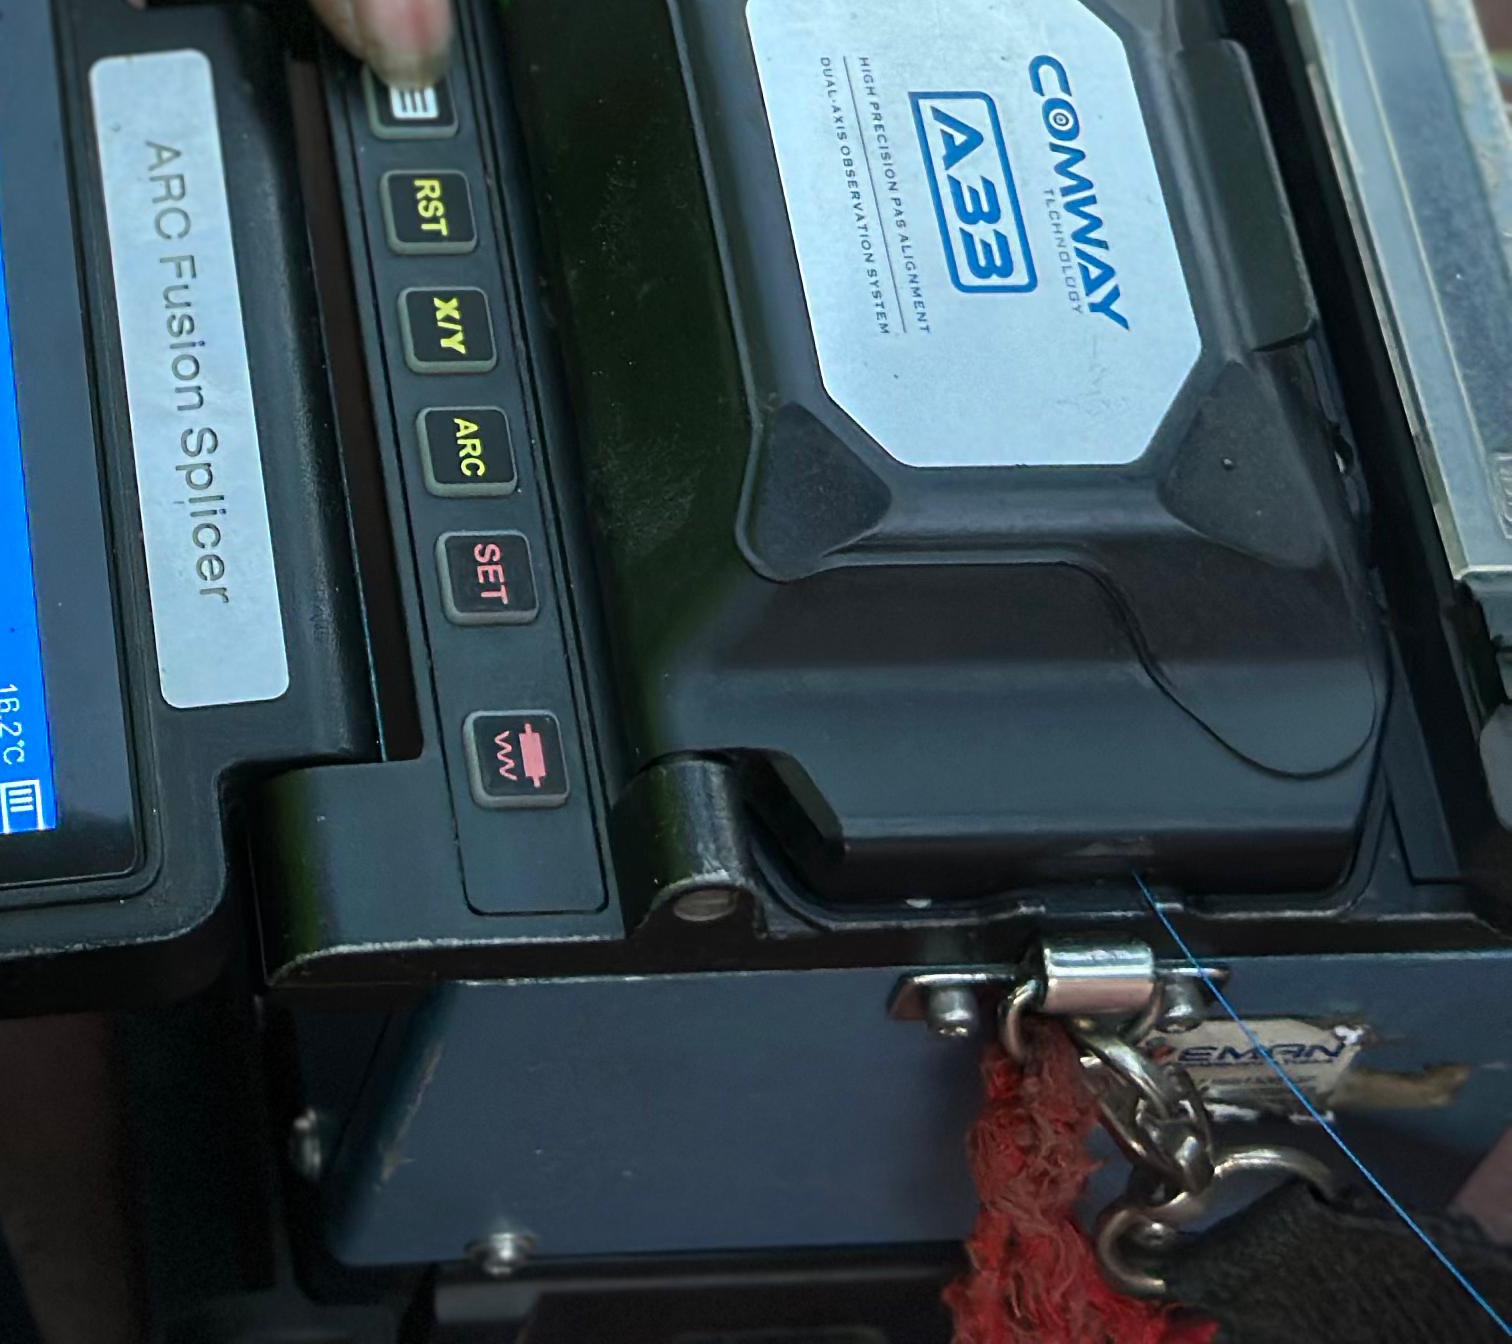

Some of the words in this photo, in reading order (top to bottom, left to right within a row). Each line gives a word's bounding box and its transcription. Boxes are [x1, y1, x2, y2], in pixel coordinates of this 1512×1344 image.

[145, 141, 192, 240] ARC
[413, 177, 449, 236] RST
[820, 56, 848, 141] DUAL-AXIS
[840, 145, 875, 263] OBSERVATION
[867, 268, 890, 335] SYSTEM
[858, 56, 876, 96] HIGH
[869, 101, 899, 192] PRECISION
[898, 233, 930, 334] ALIGNMENT
[930, 106, 1015, 279] A33
[1028, 54, 1130, 331] COMWAY
[1043, 188, 1084, 314] TECHNOLOGY
[158, 255, 210, 411] Fusion
[432, 296, 466, 356] X/Y
[174, 428, 234, 605] Splicer
[453, 417, 486, 477] ARC
[473, 542, 508, 605] SET
